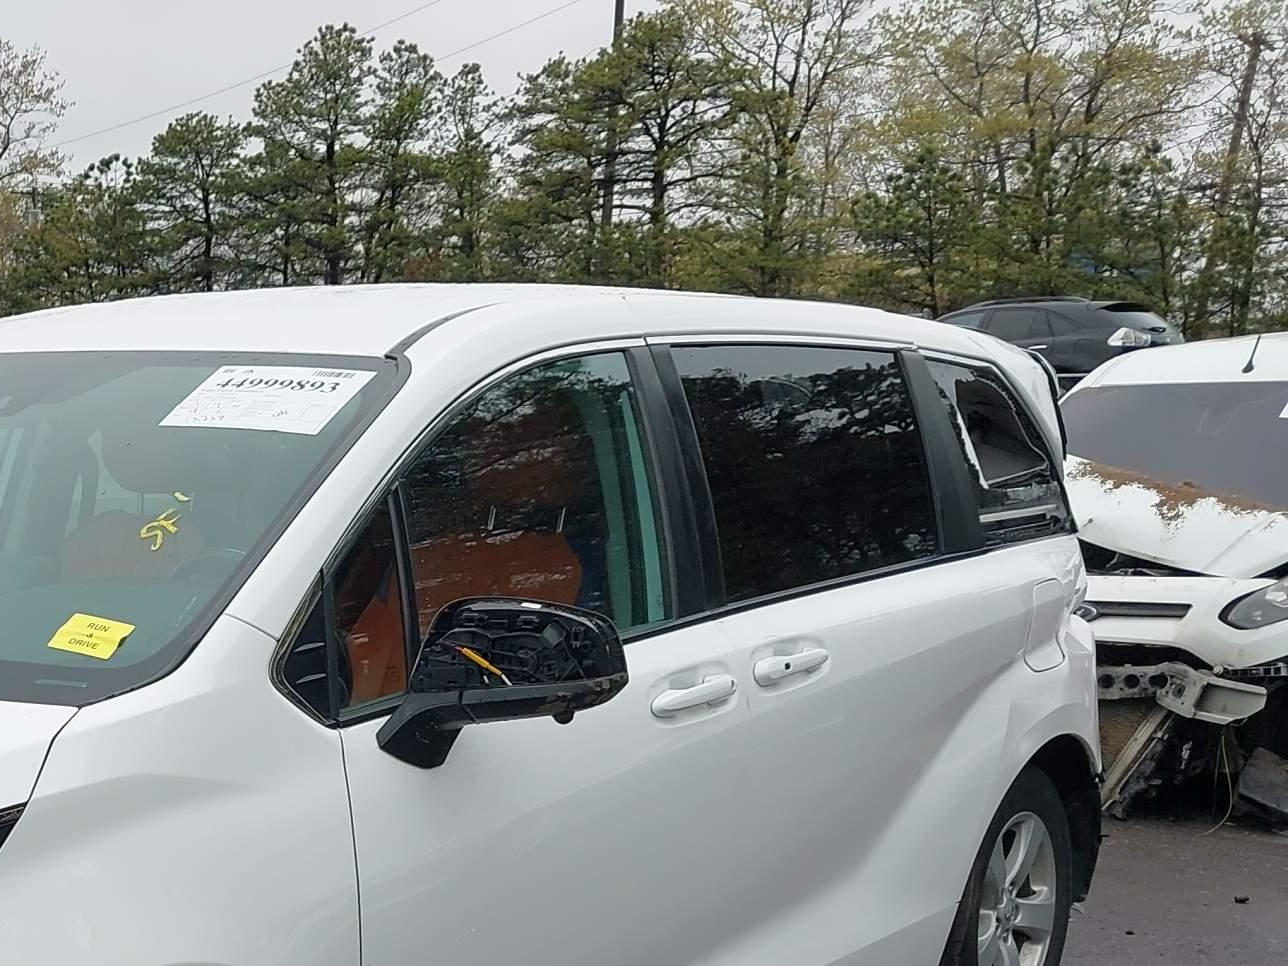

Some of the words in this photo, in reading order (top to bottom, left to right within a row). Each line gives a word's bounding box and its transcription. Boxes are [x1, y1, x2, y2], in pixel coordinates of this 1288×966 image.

[216, 377, 341, 394] 44999893
[87, 622, 111, 633] RUN
[68, 637, 101, 650] DRIVE
